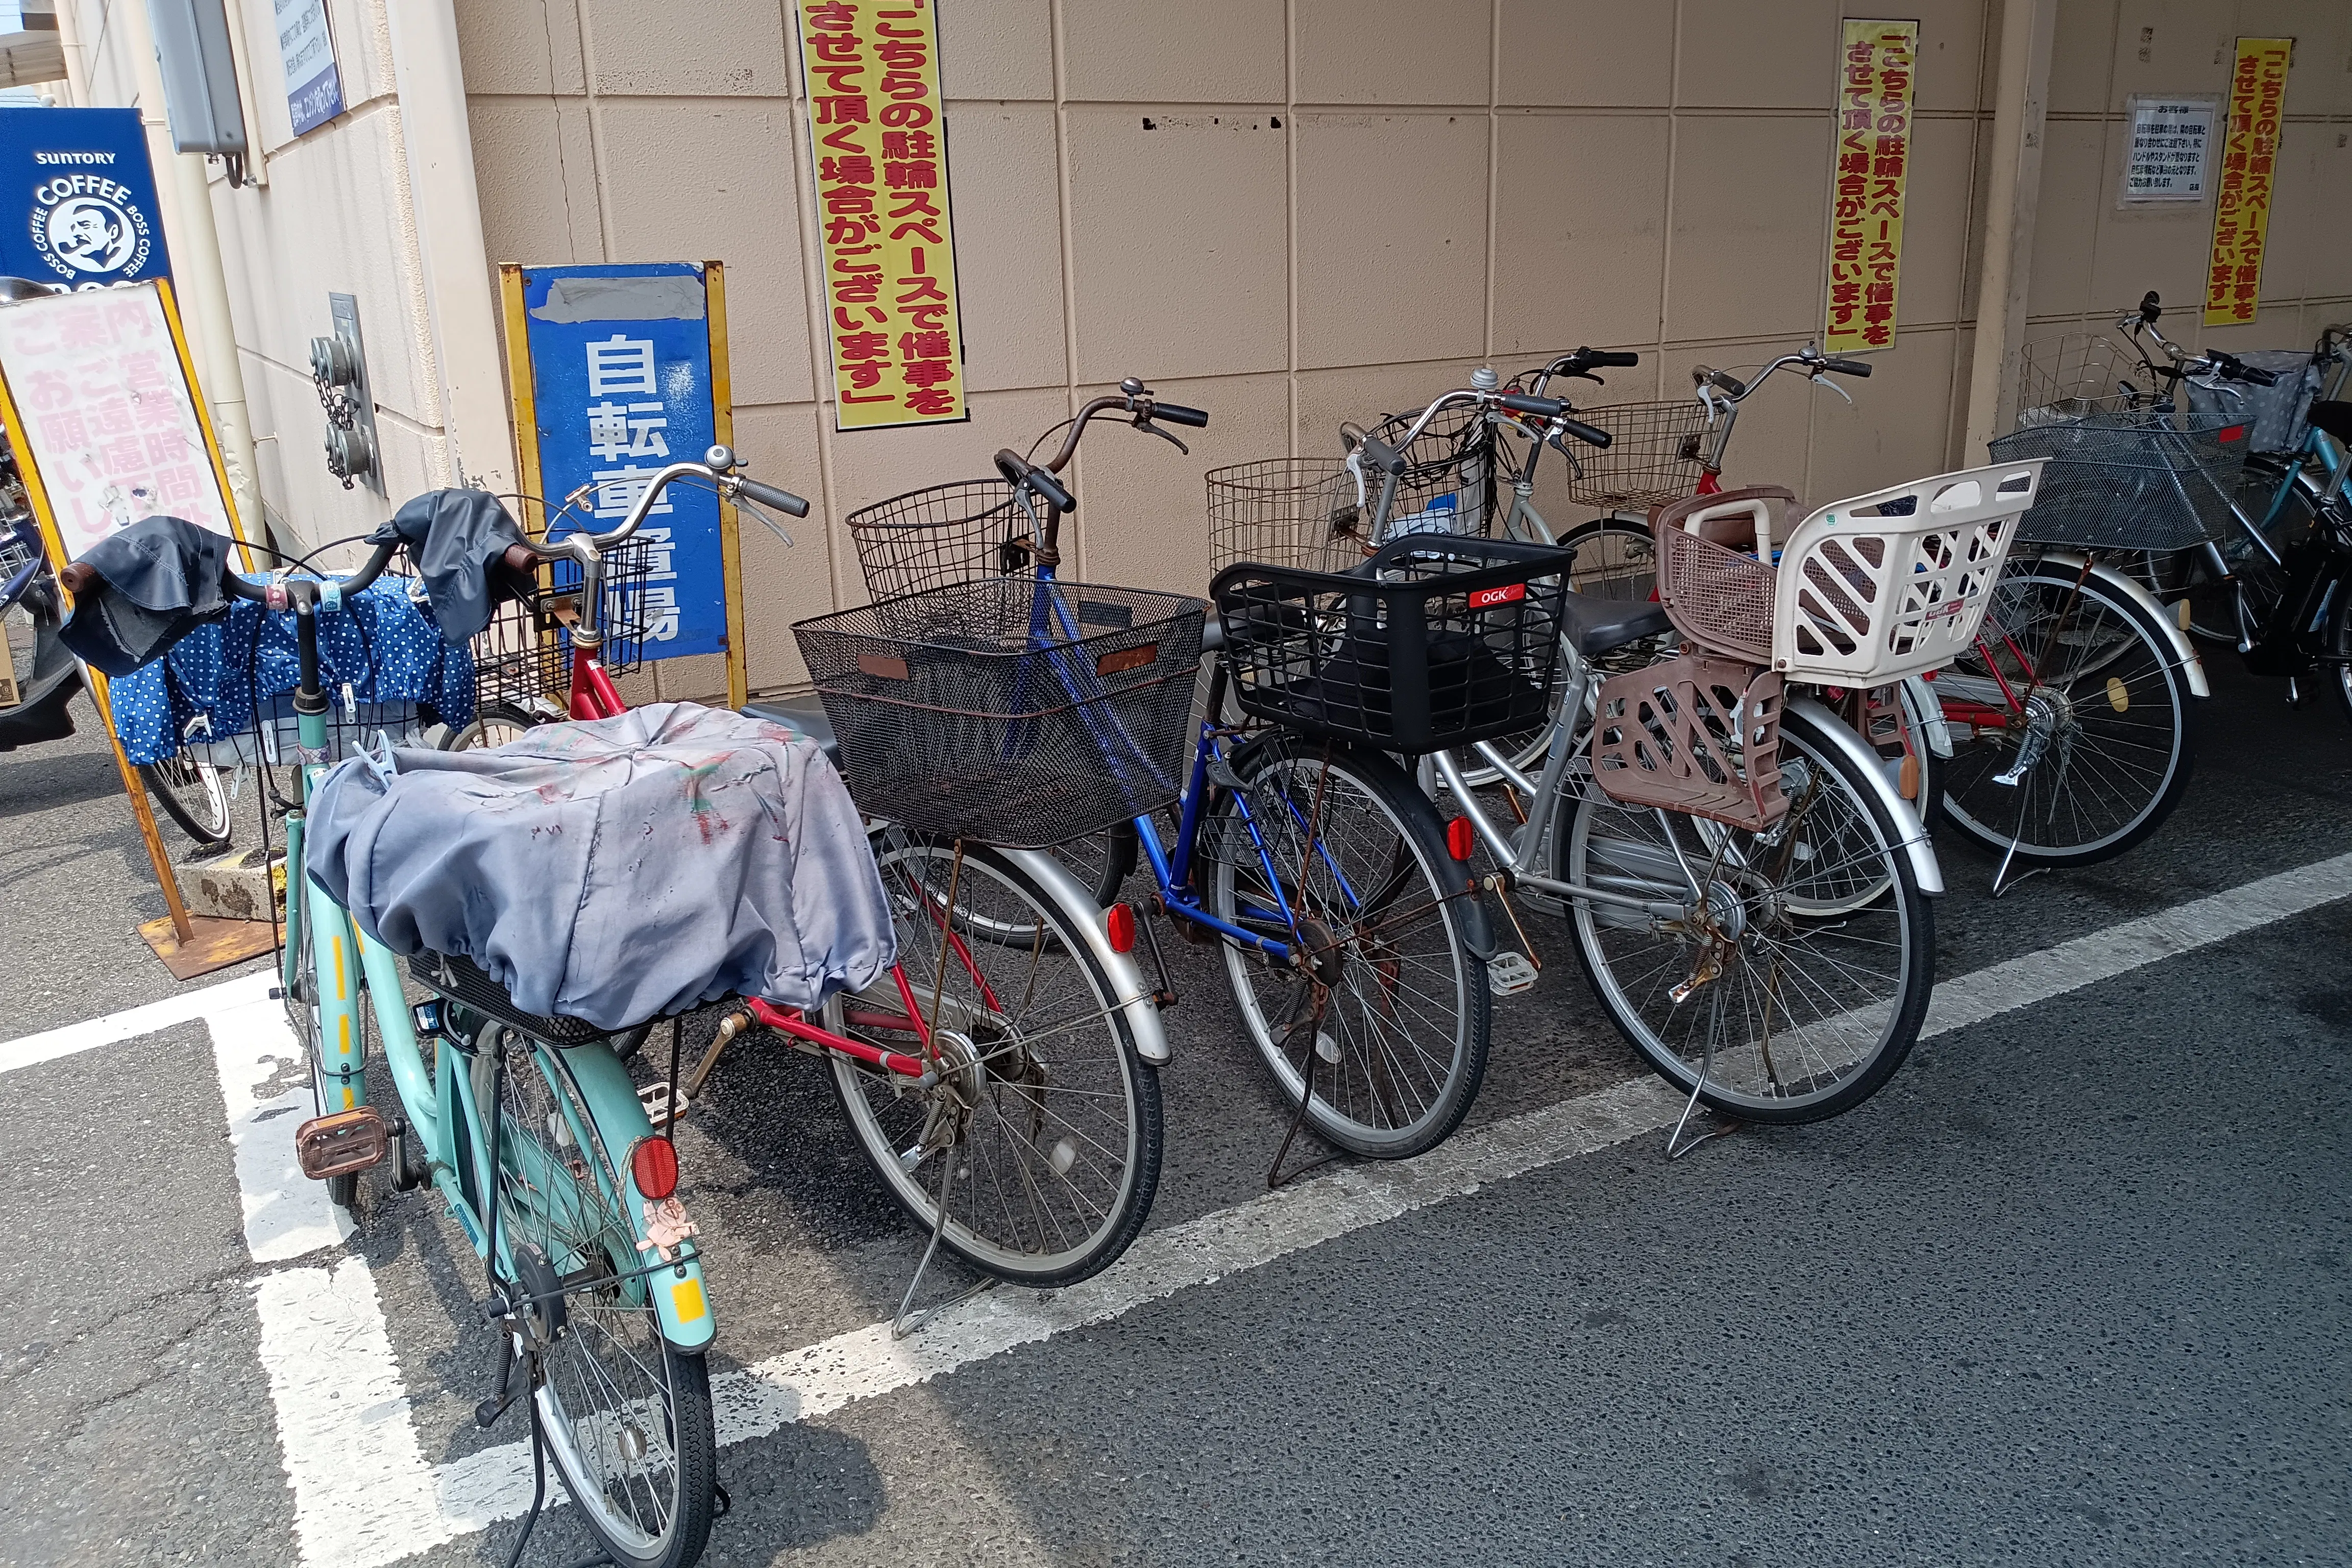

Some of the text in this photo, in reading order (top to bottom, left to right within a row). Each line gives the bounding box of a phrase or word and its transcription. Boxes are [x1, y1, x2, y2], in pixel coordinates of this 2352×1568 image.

[32, 206, 77, 280] BOSS COFFEE
[37, 175, 132, 206] COFFEE
[122, 205, 151, 278] BOSS COFFEE
[805, 1, 896, 405] させて頂く場合がございます」
[873, 0, 955, 415] こちらの駐輪スペースで催事を
[1828, 40, 1875, 336] させて頂く場合がございます」
[1861, 35, 1911, 345] 「こちらの駐輪スペースで催事を
[2207, 55, 2260, 311] させて頂く場合がございます」
[2232, 50, 2286, 320] 「こちらの駐輪スペースで催事を
[10, 298, 154, 356] ご案内
[25, 369, 113, 551] お願いし
[1481, 586, 1509, 603] OGK
